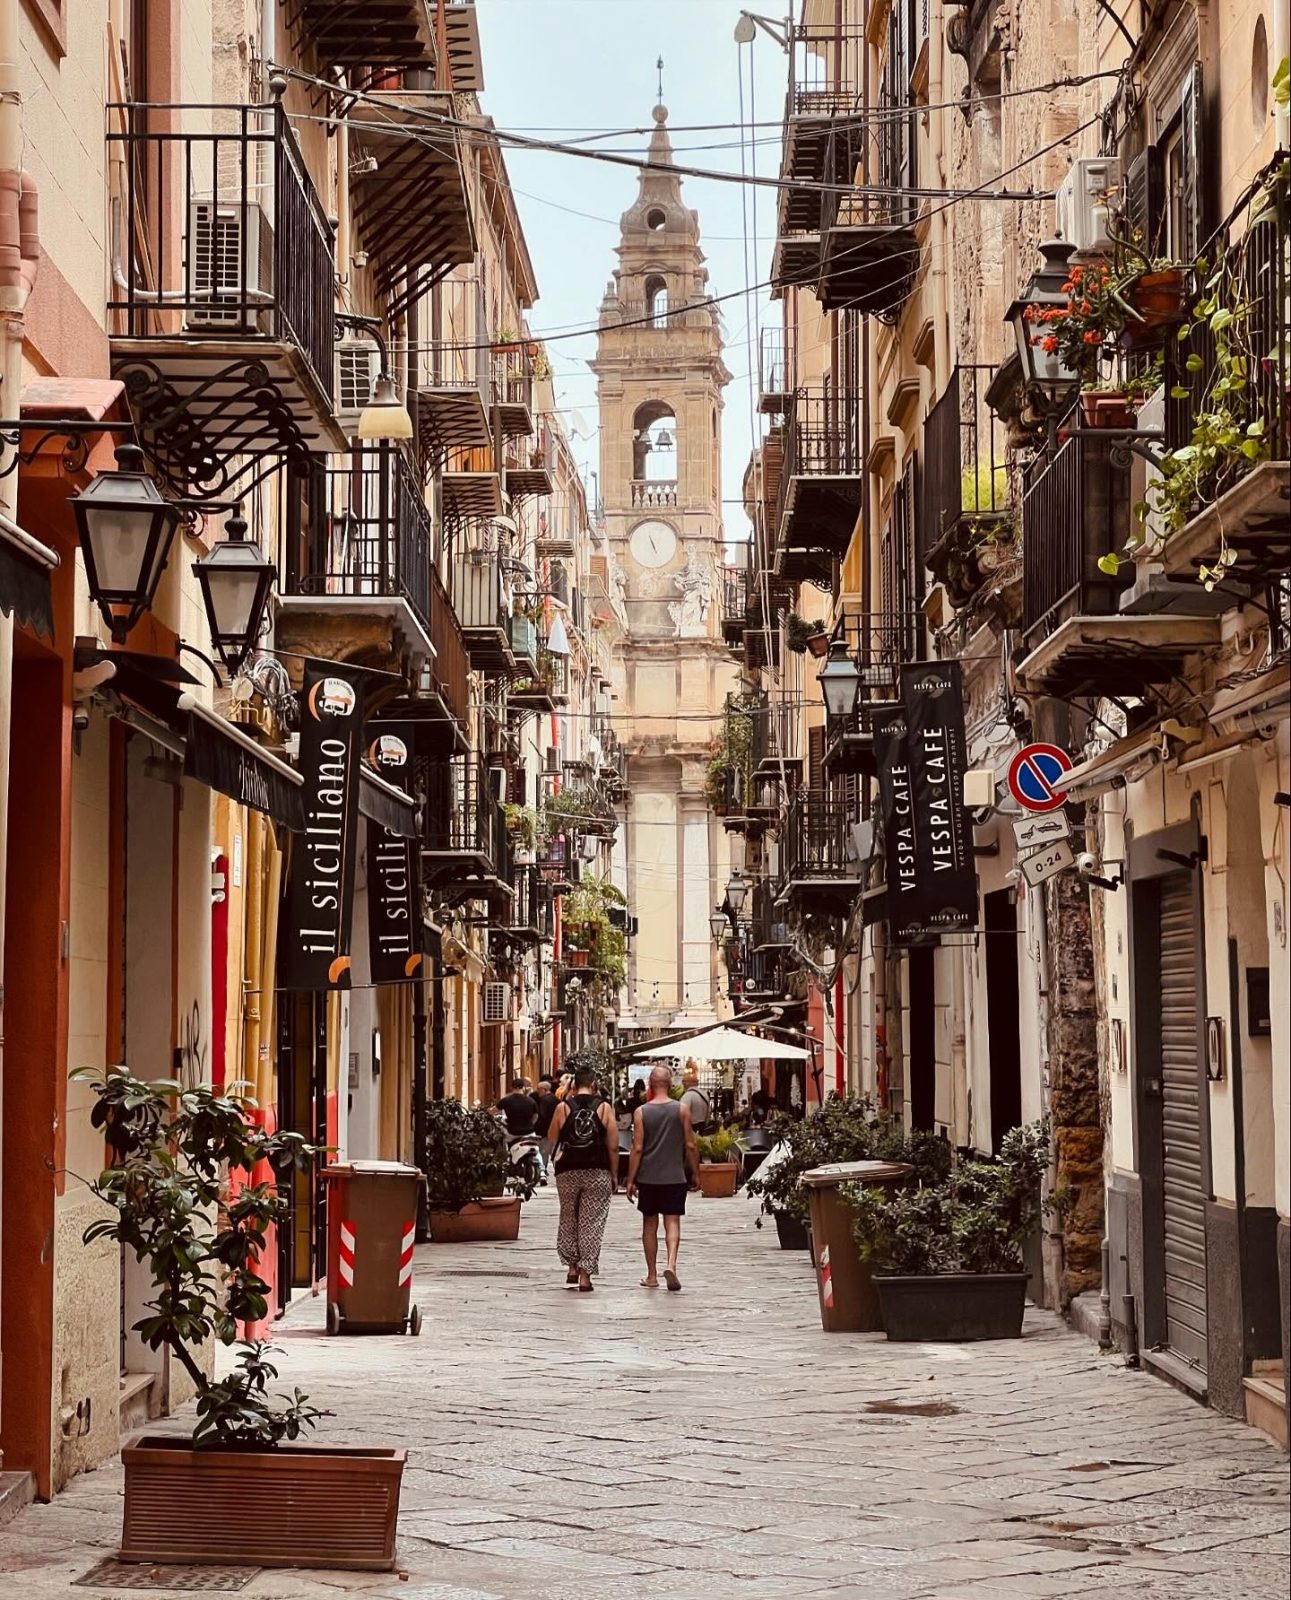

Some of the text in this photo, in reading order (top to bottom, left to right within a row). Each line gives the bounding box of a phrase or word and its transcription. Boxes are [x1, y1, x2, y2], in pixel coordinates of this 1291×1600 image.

[305, 739, 346, 909] siciliano
[376, 785, 408, 919] sicili
[891, 765, 916, 892] VESPA CAFE
[923, 727, 952, 872] VESPA CAFE
[1035, 851, 1062, 872] 0-24
[300, 929, 336, 953] il
[379, 934, 409, 954] il
